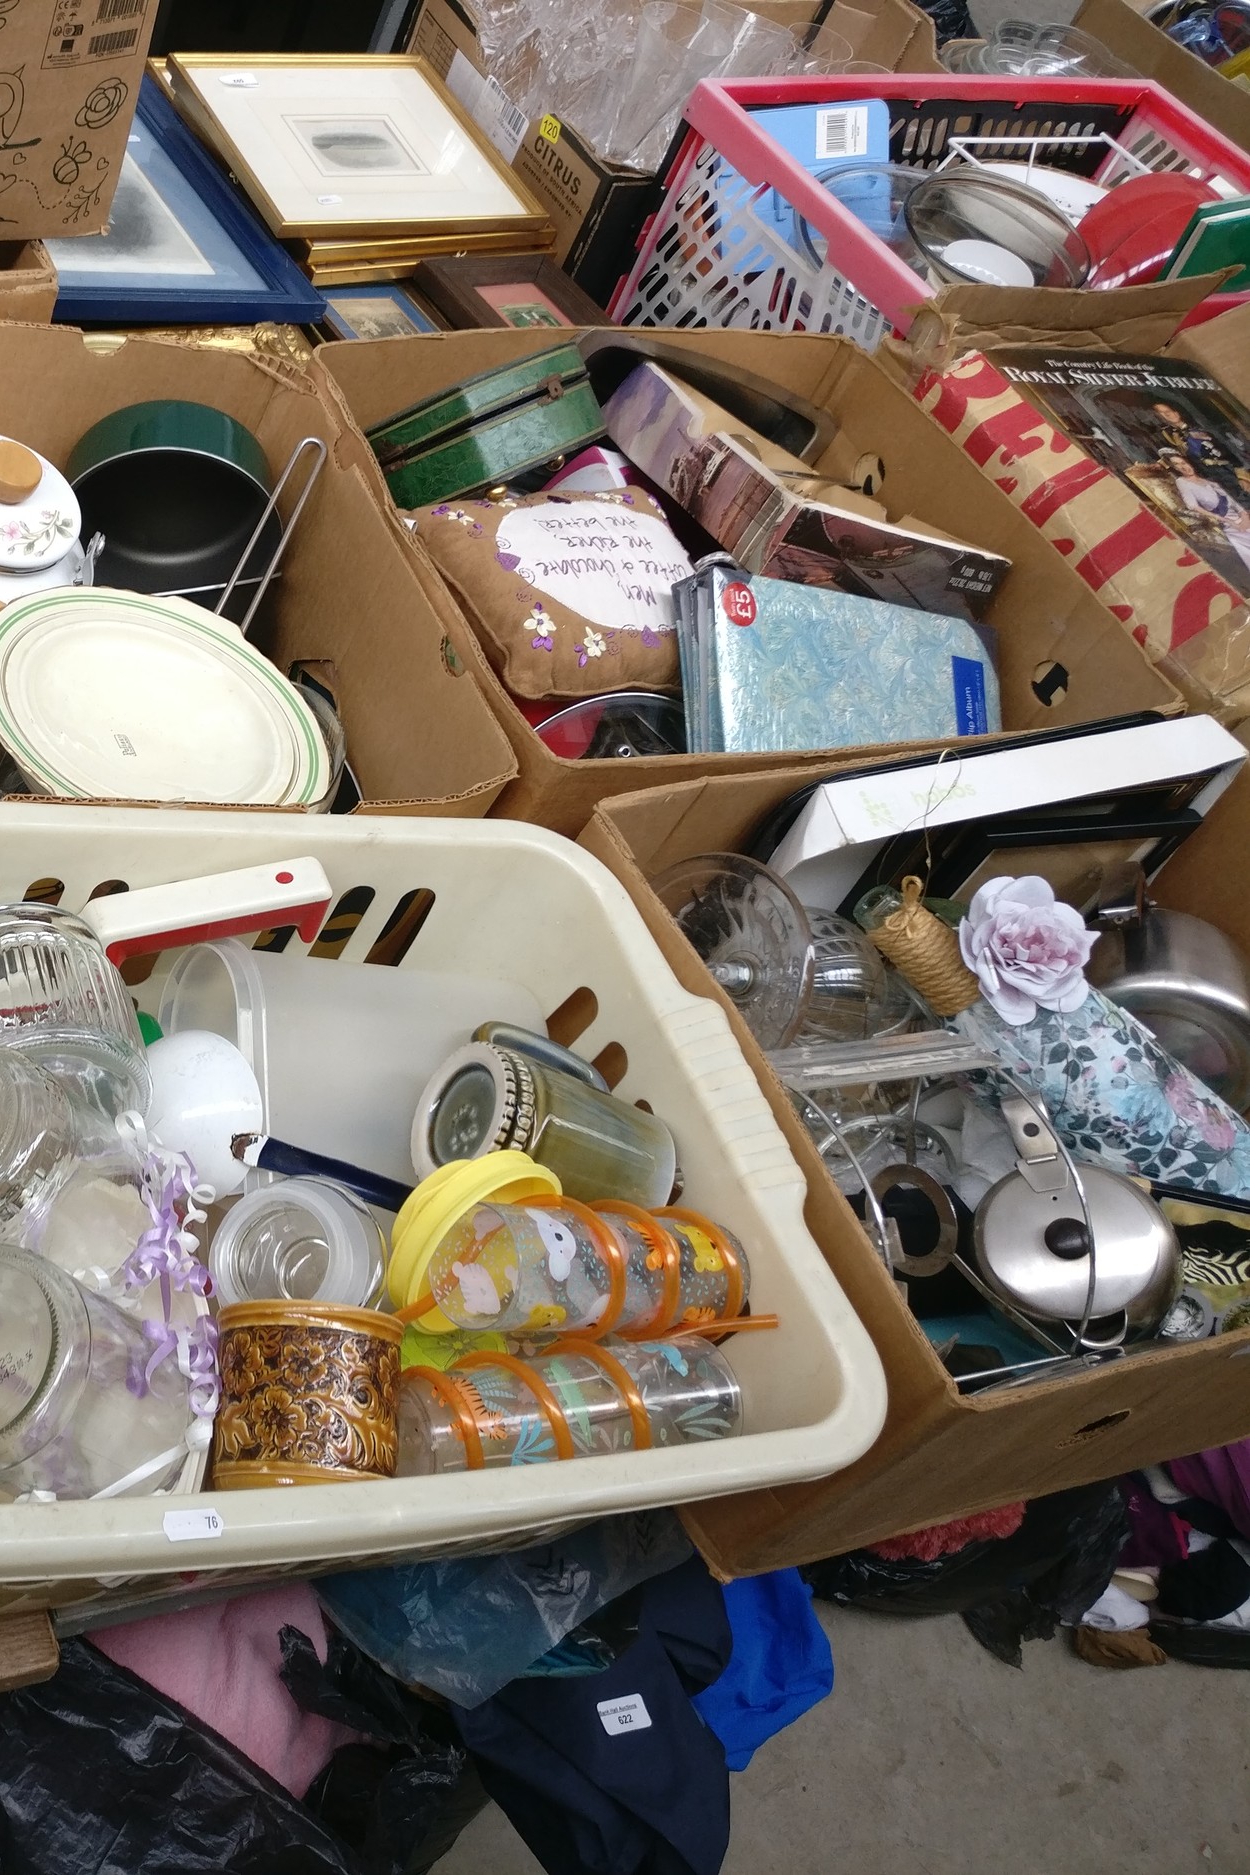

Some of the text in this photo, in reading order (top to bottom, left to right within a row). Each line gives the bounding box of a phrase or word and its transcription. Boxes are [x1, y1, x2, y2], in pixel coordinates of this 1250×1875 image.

[544, 120, 558, 139] 120
[534, 135, 582, 196] CITRUS
[1001, 366, 1074, 385] ROYAL
[1069, 369, 1146, 387] SILVER
[735, 590, 752, 619] £5
[964, 686, 974, 720] Album
[205, 1516, 218, 1529] 76
[618, 1714, 634, 1725] 622
